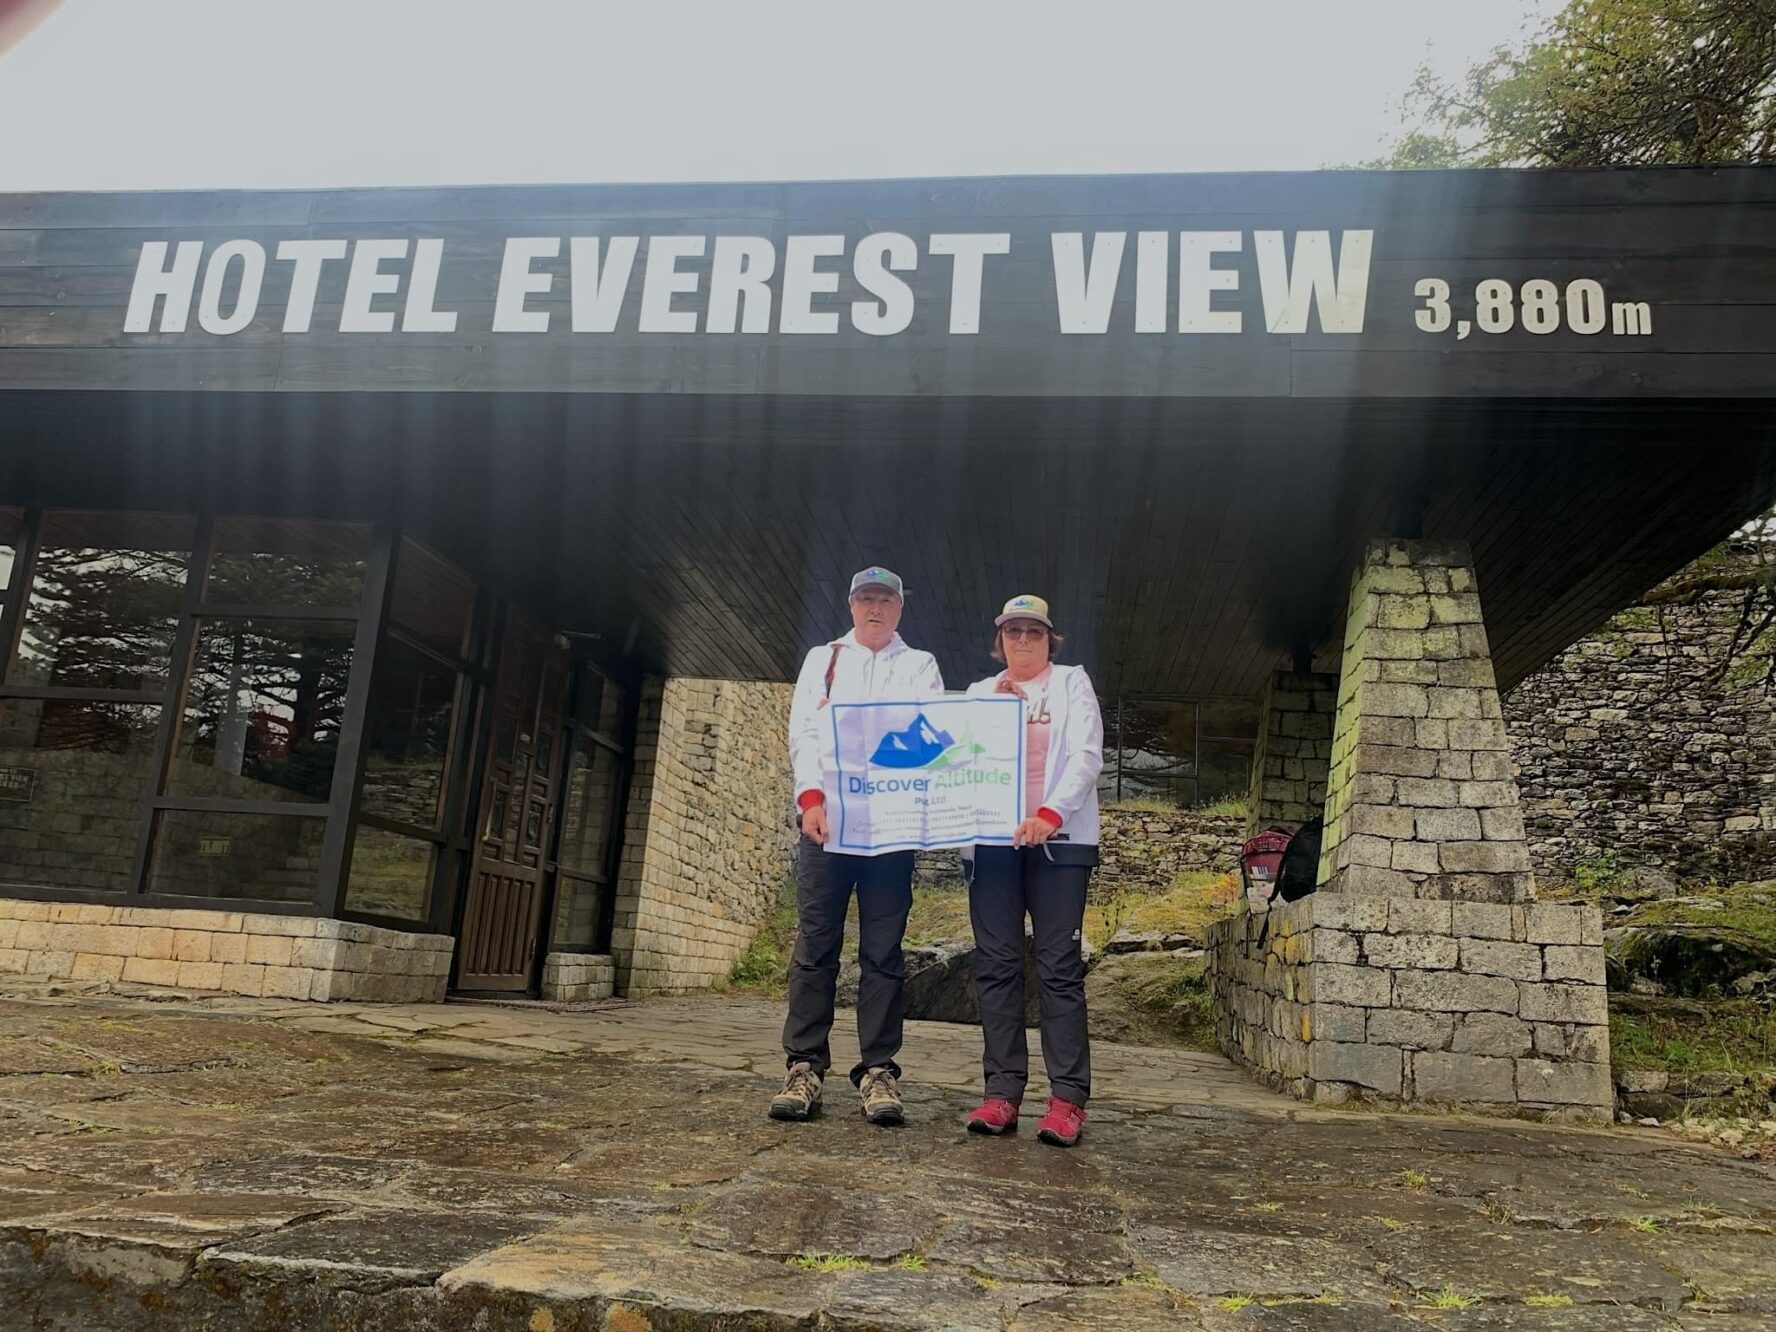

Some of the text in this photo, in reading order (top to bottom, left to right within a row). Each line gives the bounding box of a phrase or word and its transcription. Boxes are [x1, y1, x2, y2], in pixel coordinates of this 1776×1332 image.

[123, 229, 1653, 341] HOTEL EVEREST VIEW 3,880m
[849, 768, 1011, 794] Discover Altitude
